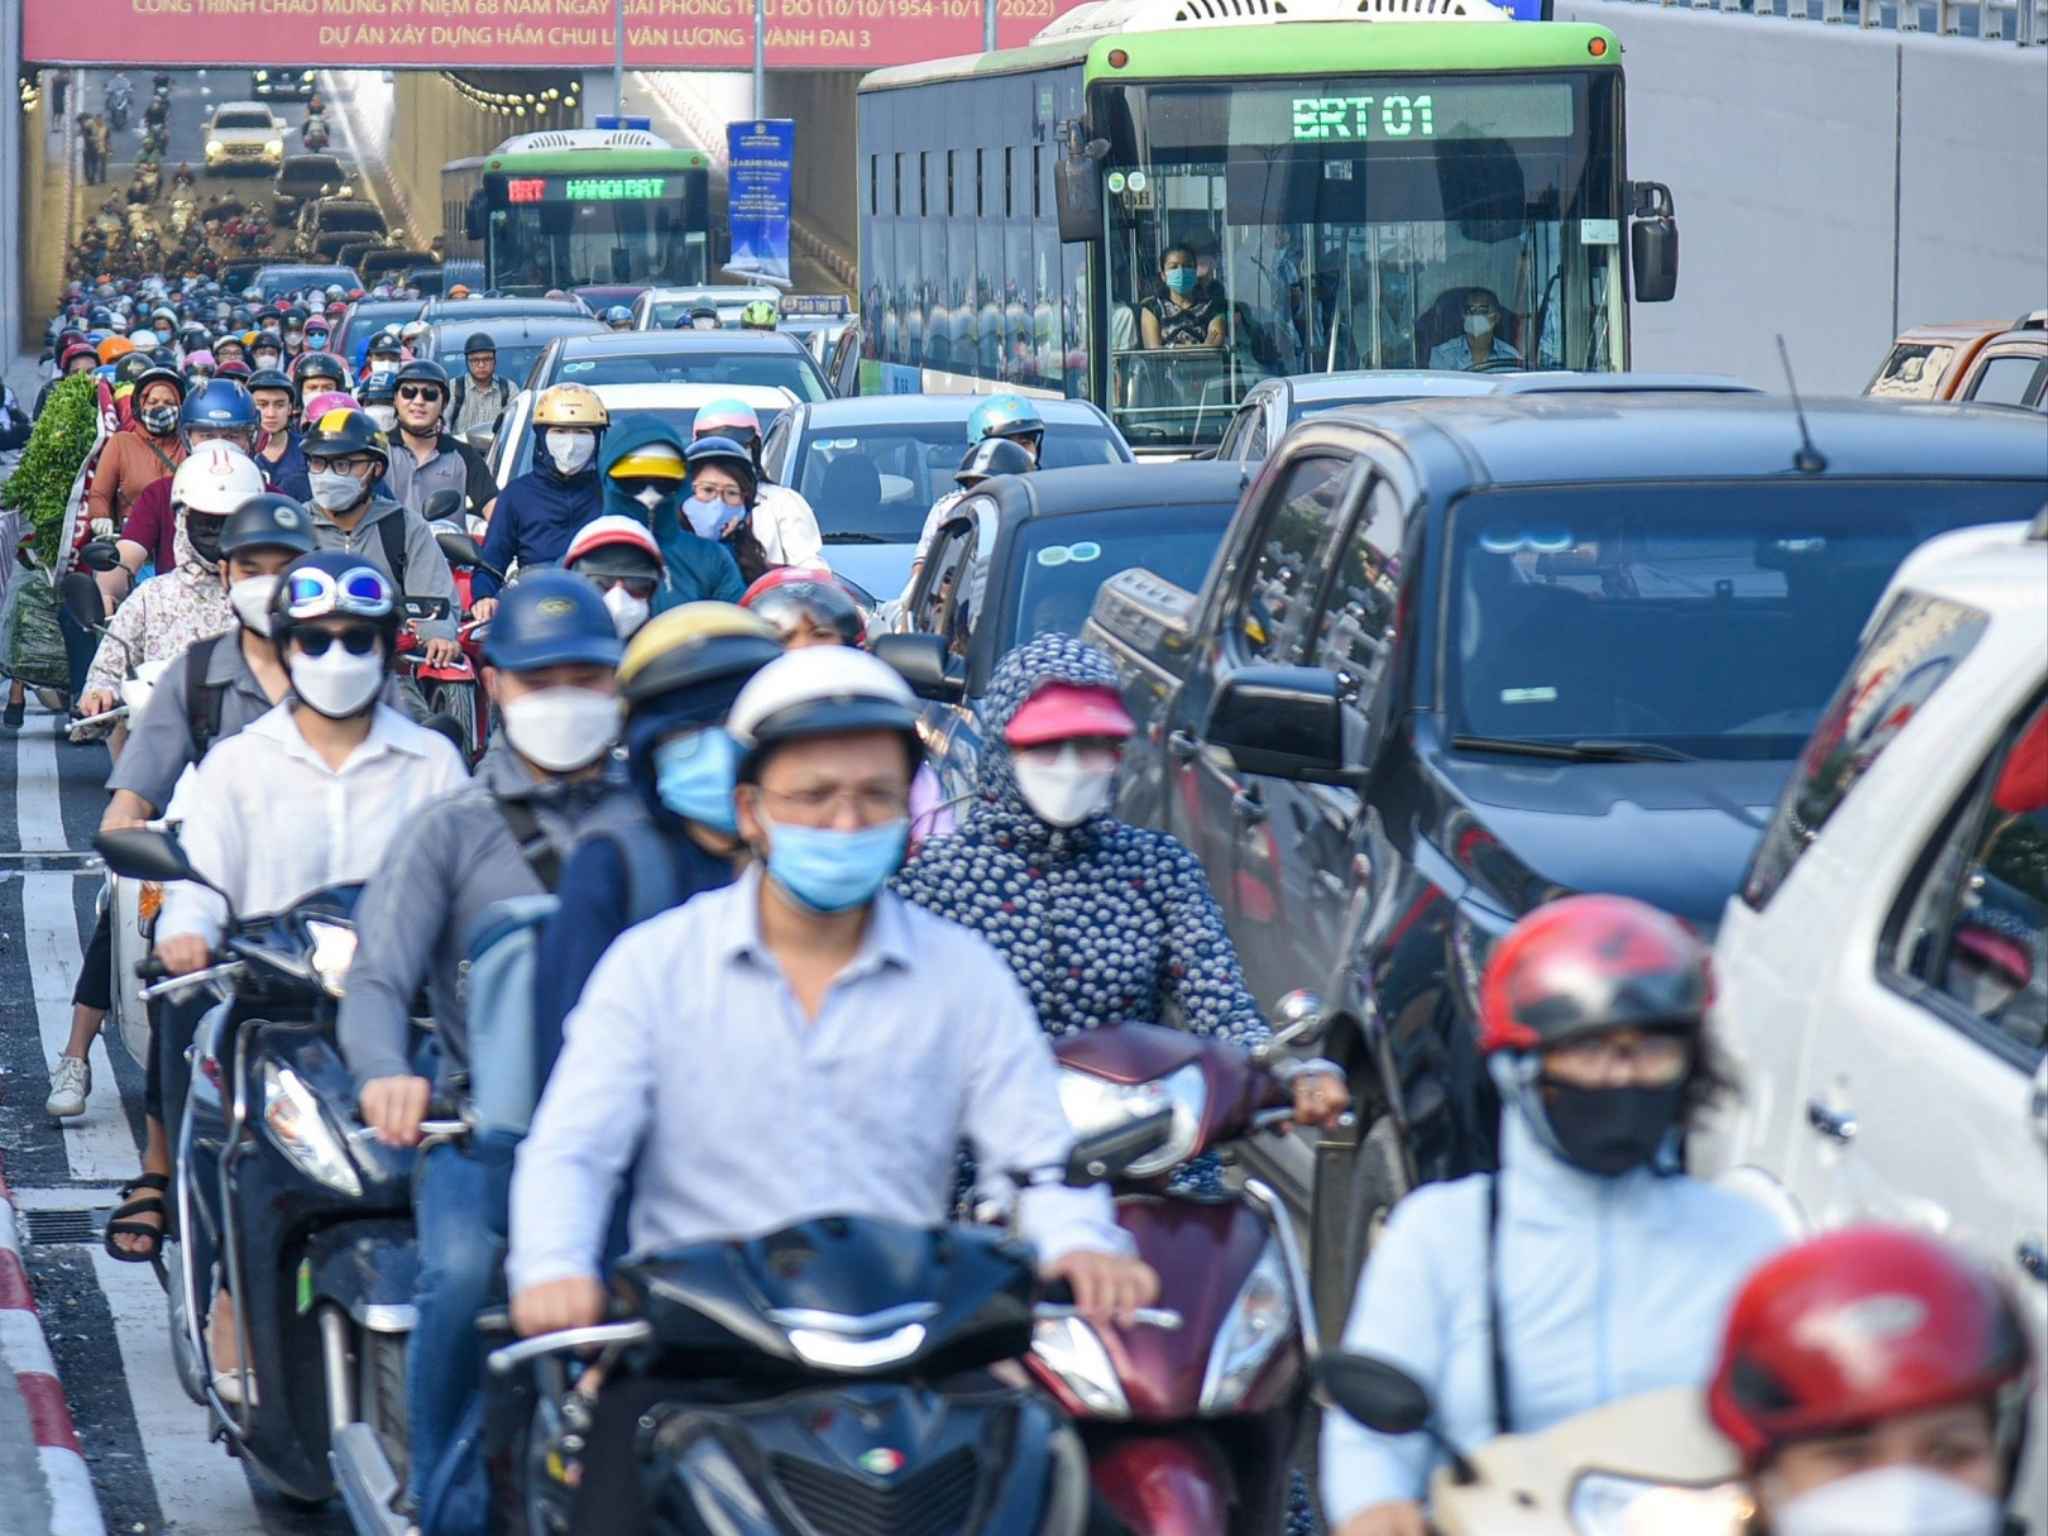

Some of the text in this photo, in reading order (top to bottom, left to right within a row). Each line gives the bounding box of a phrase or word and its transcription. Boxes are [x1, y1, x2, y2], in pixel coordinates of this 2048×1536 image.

[475, 0, 498, 14] 68
[548, 26, 597, 45] CHUI
[819, 29, 855, 48] ĐAI
[859, 30, 872, 48] 3
[1292, 95, 1433, 138] BRT 01
[508, 179, 545, 203] BRT
[624, 178, 664, 199] BRT
